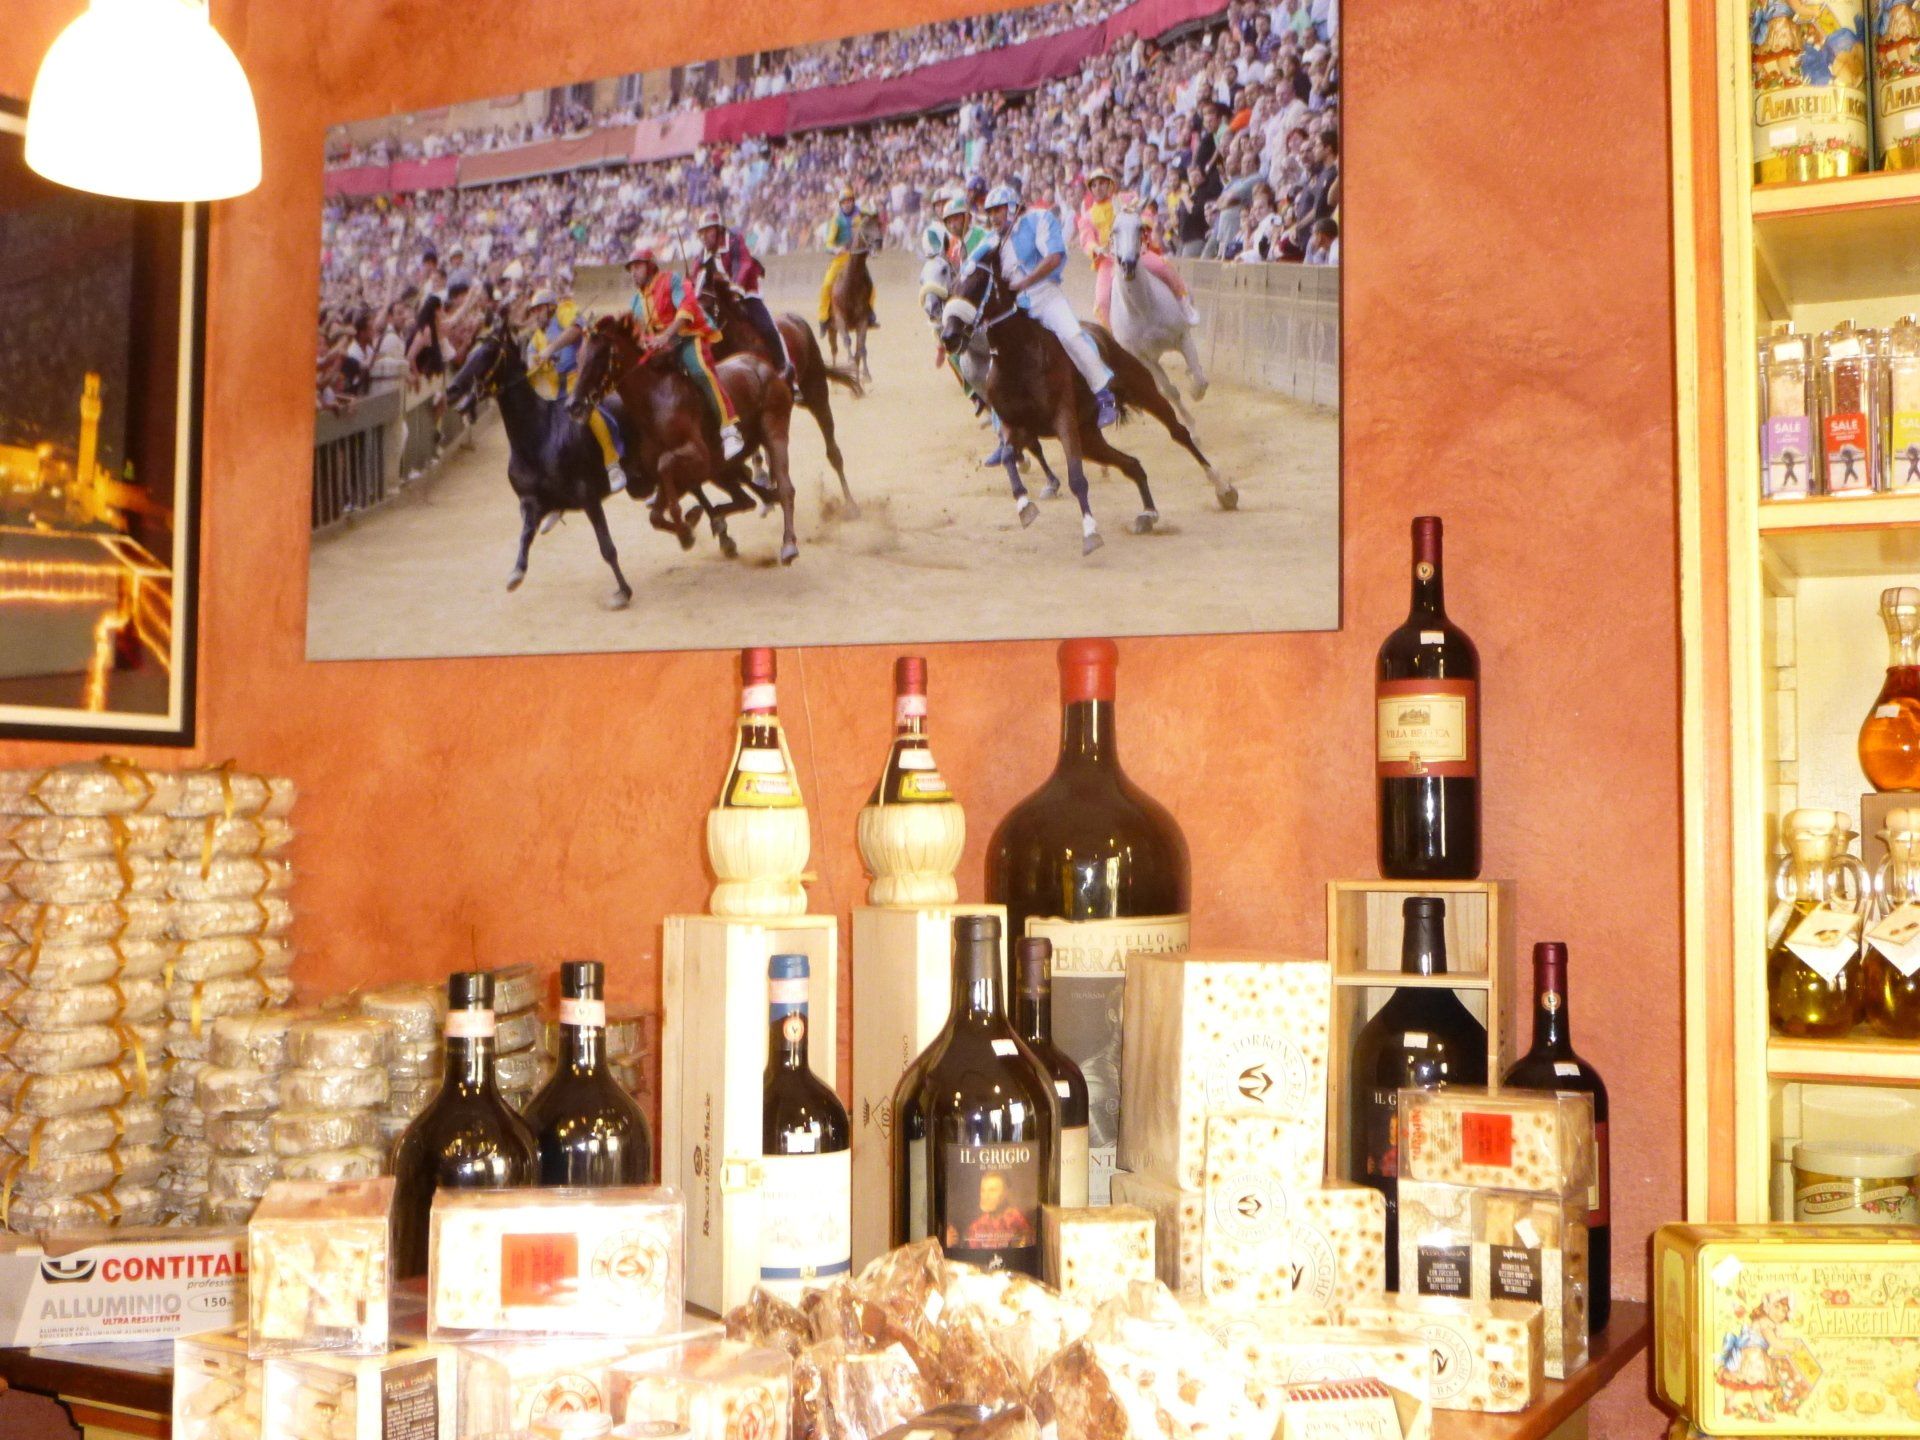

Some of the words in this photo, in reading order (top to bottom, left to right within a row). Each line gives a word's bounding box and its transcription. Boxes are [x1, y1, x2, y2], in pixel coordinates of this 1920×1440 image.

[1774, 422, 1801, 434] SALE
[1831, 419, 1858, 432] SALE
[1900, 418, 1920, 428] SAL
[1375, 1091, 1386, 1105] IL
[960, 1148, 976, 1164] IL
[979, 1147, 1030, 1164] GRIGIO
[102, 1251, 248, 1283] CONTITAL
[40, 1293, 182, 1321] ALLUMINIO
[102, 1317, 129, 1326] ULTRA
[131, 1314, 181, 1325] RESISTENTE
